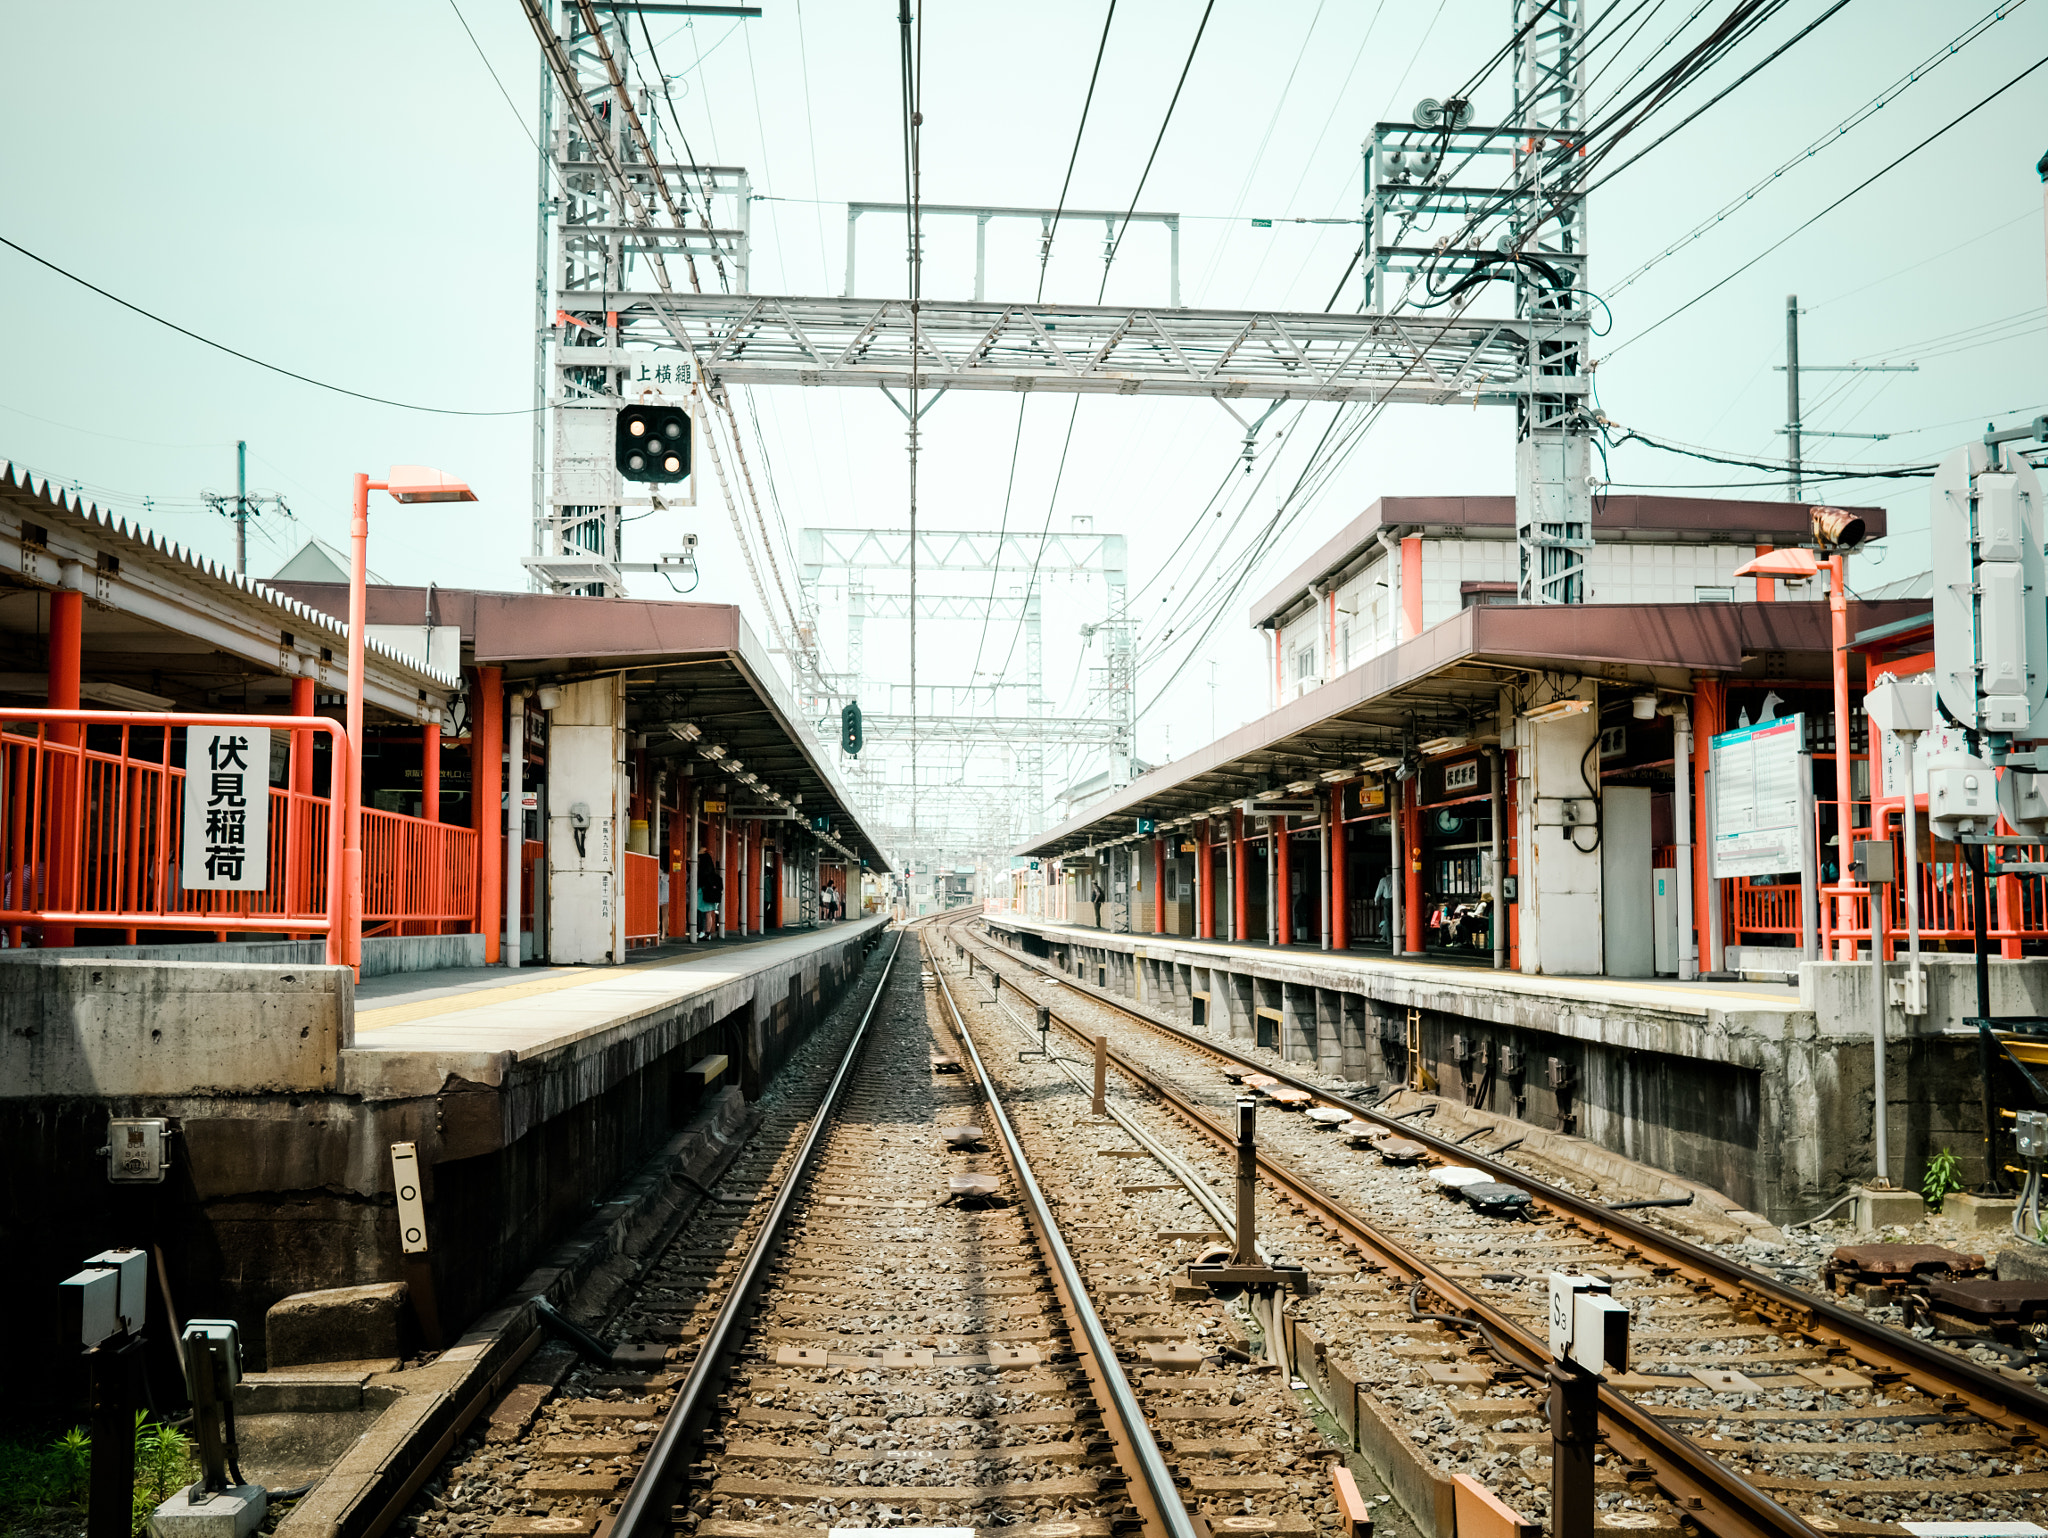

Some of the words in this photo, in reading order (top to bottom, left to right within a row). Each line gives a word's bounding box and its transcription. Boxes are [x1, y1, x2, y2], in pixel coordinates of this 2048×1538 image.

[205, 735, 249, 882] 伏見稲荷
[817, 817, 823, 828] 1
[1143, 820, 1150, 831] 2
[887, 1450, 933, 1458] 500
